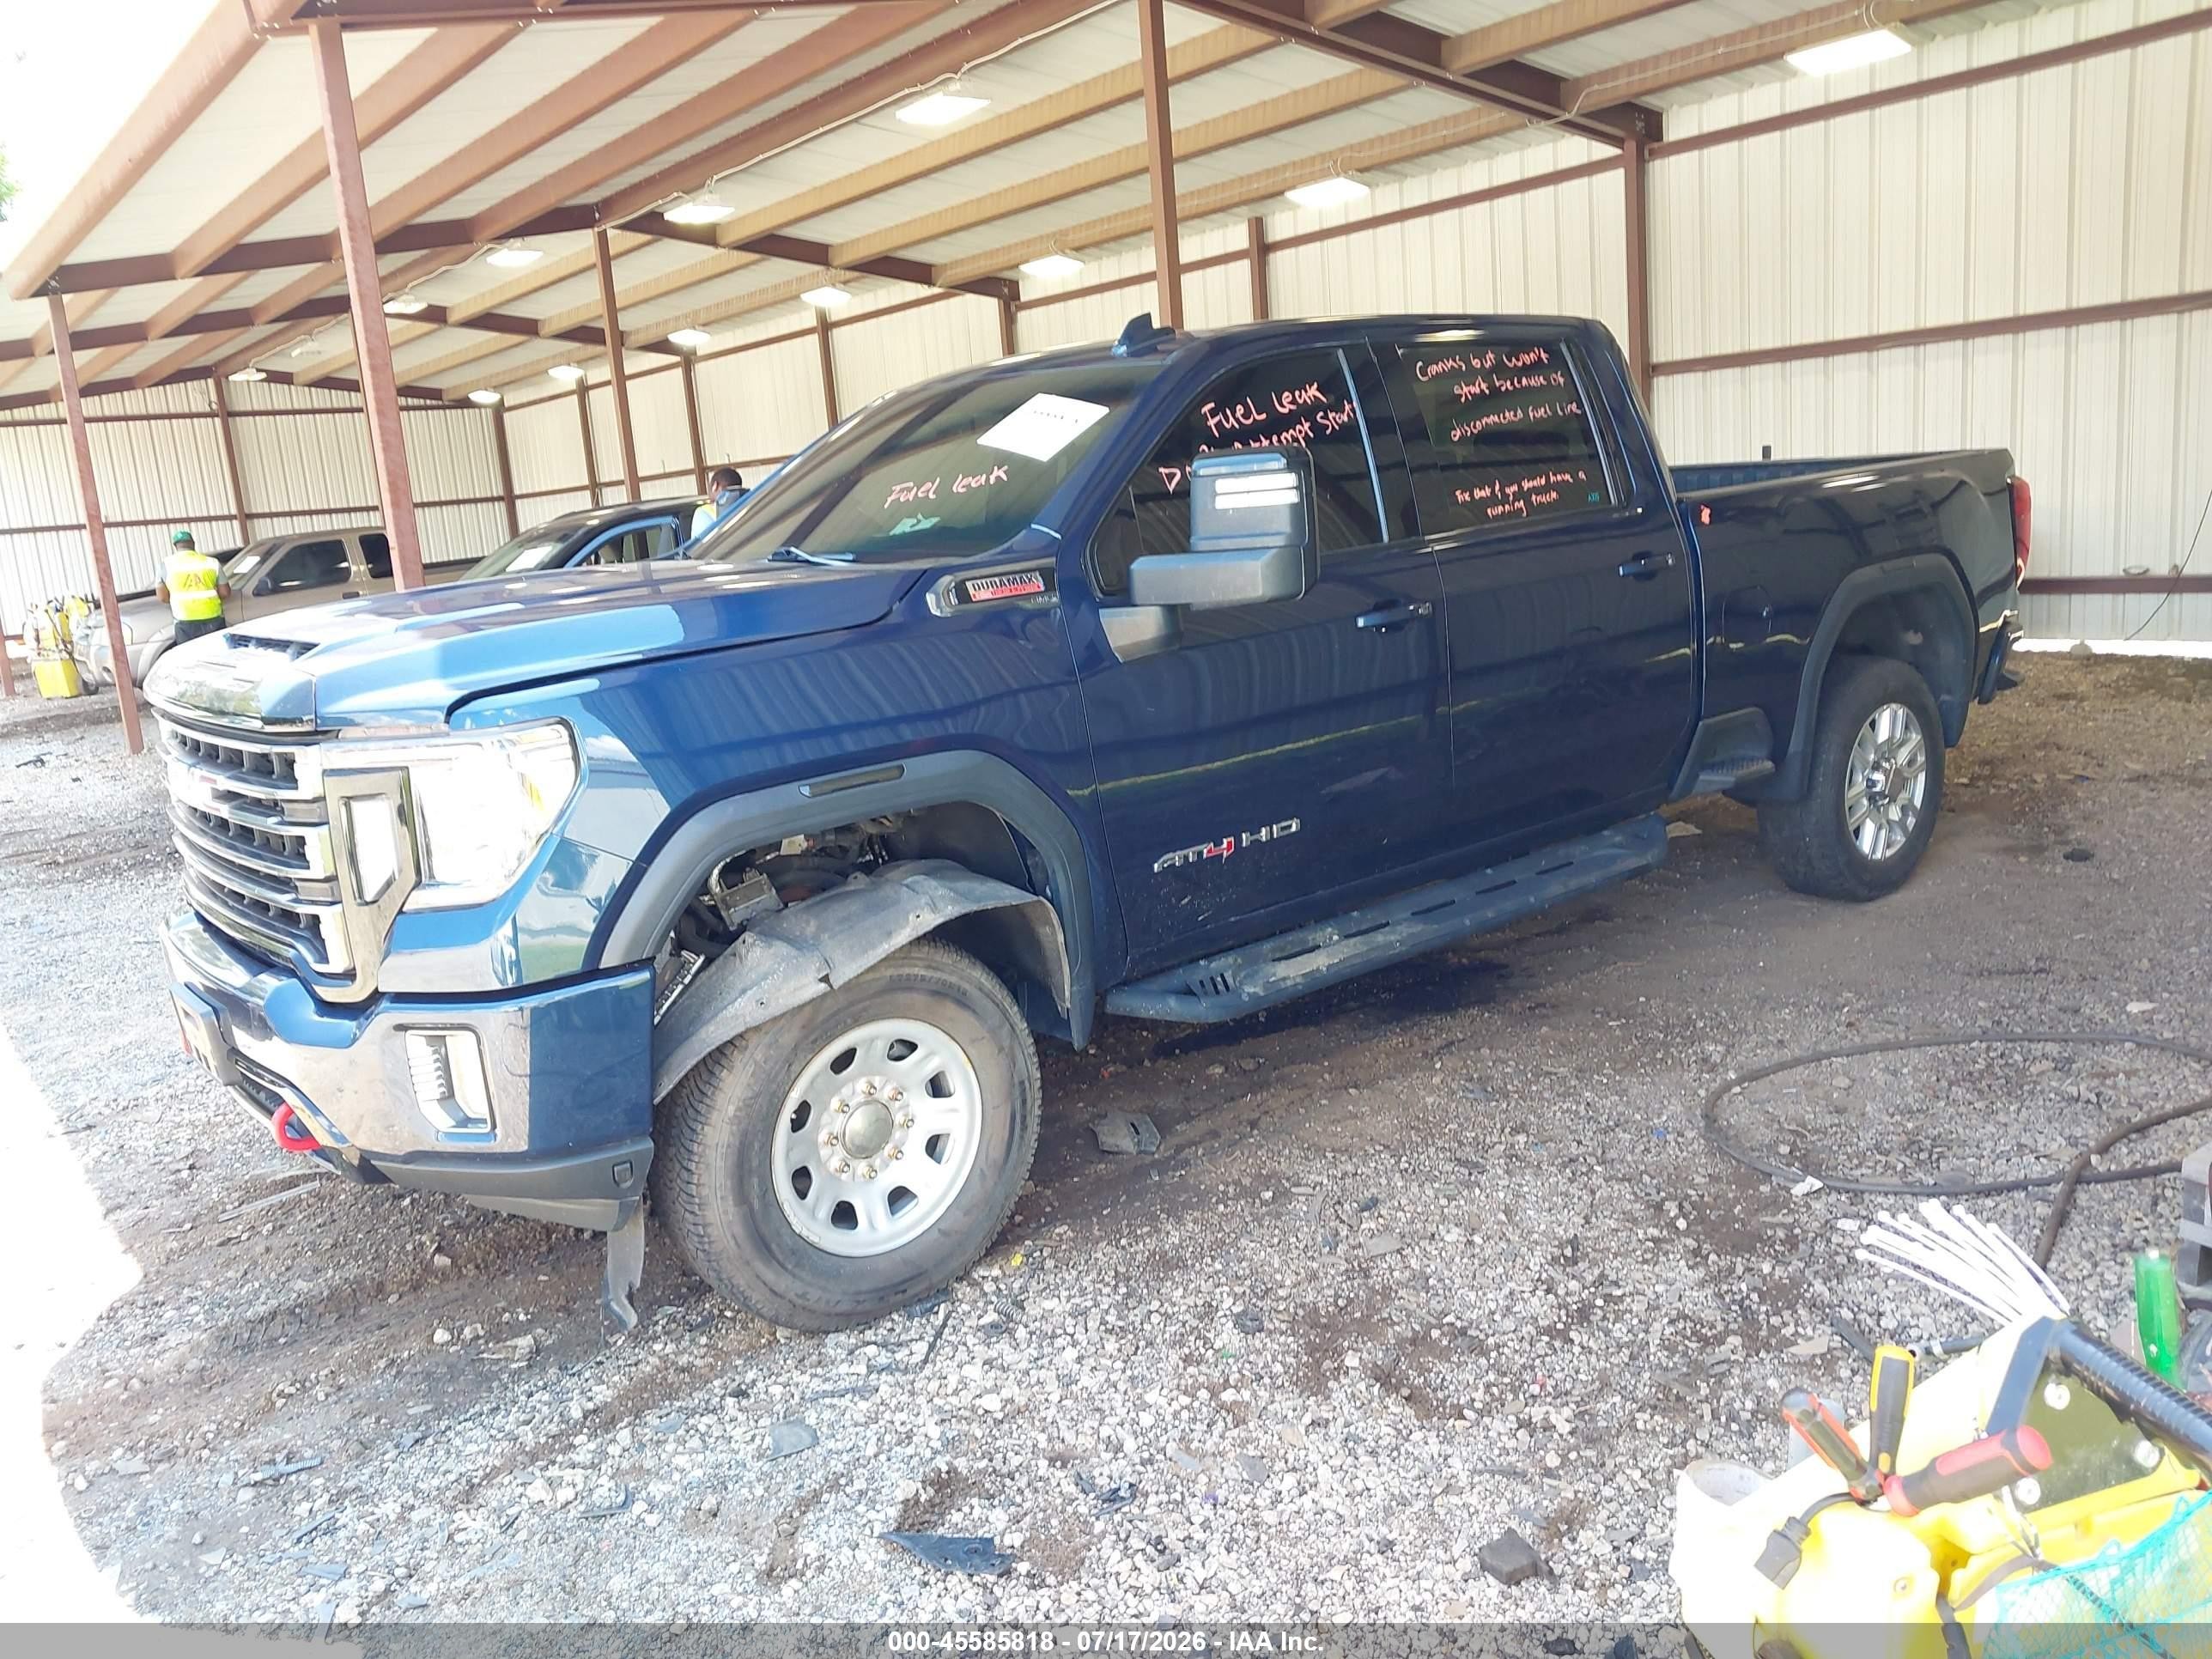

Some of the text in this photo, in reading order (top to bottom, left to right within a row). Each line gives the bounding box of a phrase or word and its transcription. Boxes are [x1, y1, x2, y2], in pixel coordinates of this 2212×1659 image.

[1416, 355, 1466, 382] Cranks
[1469, 349, 1496, 369] but
[1454, 374, 1490, 404] start
[1492, 373, 1547, 392] because
[1450, 405, 1524, 442] disconnected
[884, 476, 941, 509] Fuel
[1549, 471, 1574, 484] have
[1486, 498, 1528, 520] running
[971, 574, 1036, 592] DURAMAX
[1153, 817, 1302, 874] AT4 HD
